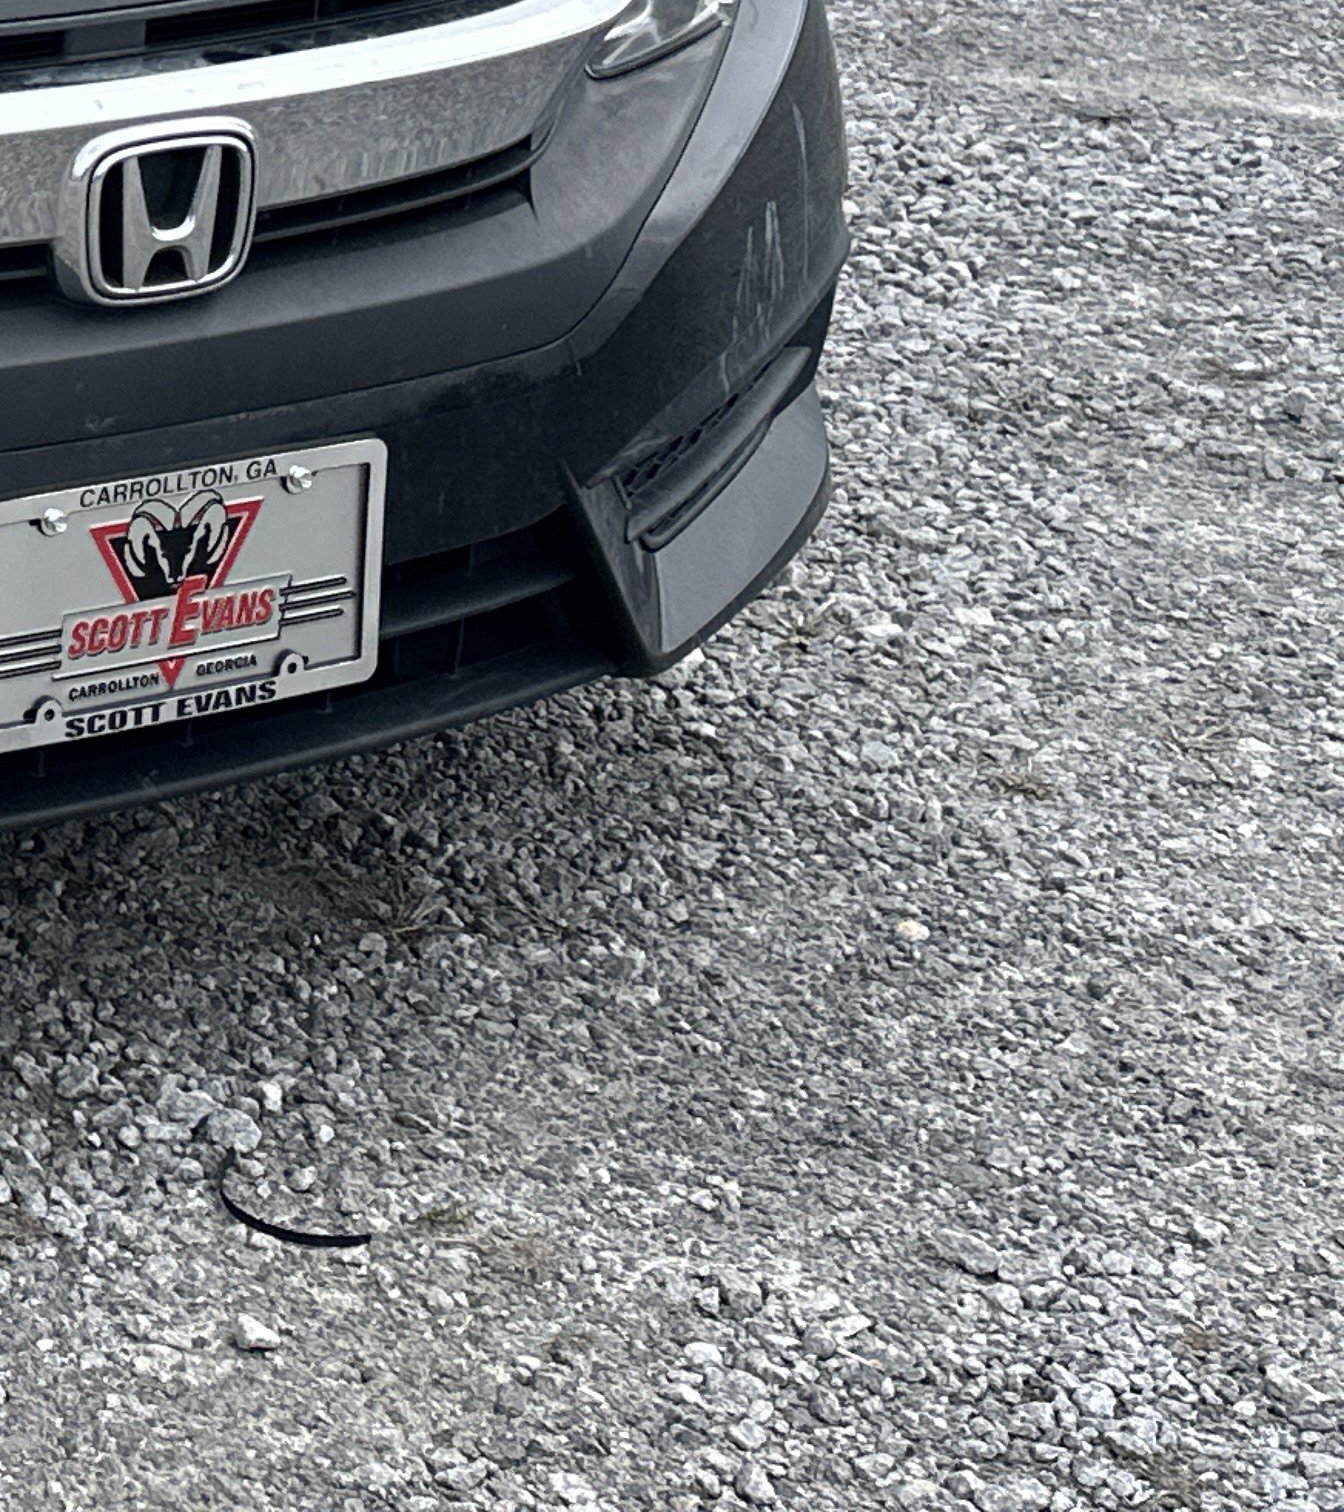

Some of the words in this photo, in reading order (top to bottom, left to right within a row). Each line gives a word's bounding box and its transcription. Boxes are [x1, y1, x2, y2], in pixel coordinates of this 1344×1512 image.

[245, 458, 278, 481] GA
[67, 605, 168, 659] SCOTT
[68, 674, 160, 702] CARROLLTON
[195, 654, 258, 677] GEORGIA
[64, 702, 168, 739] SCOTT
[176, 680, 277, 715] EVANS
